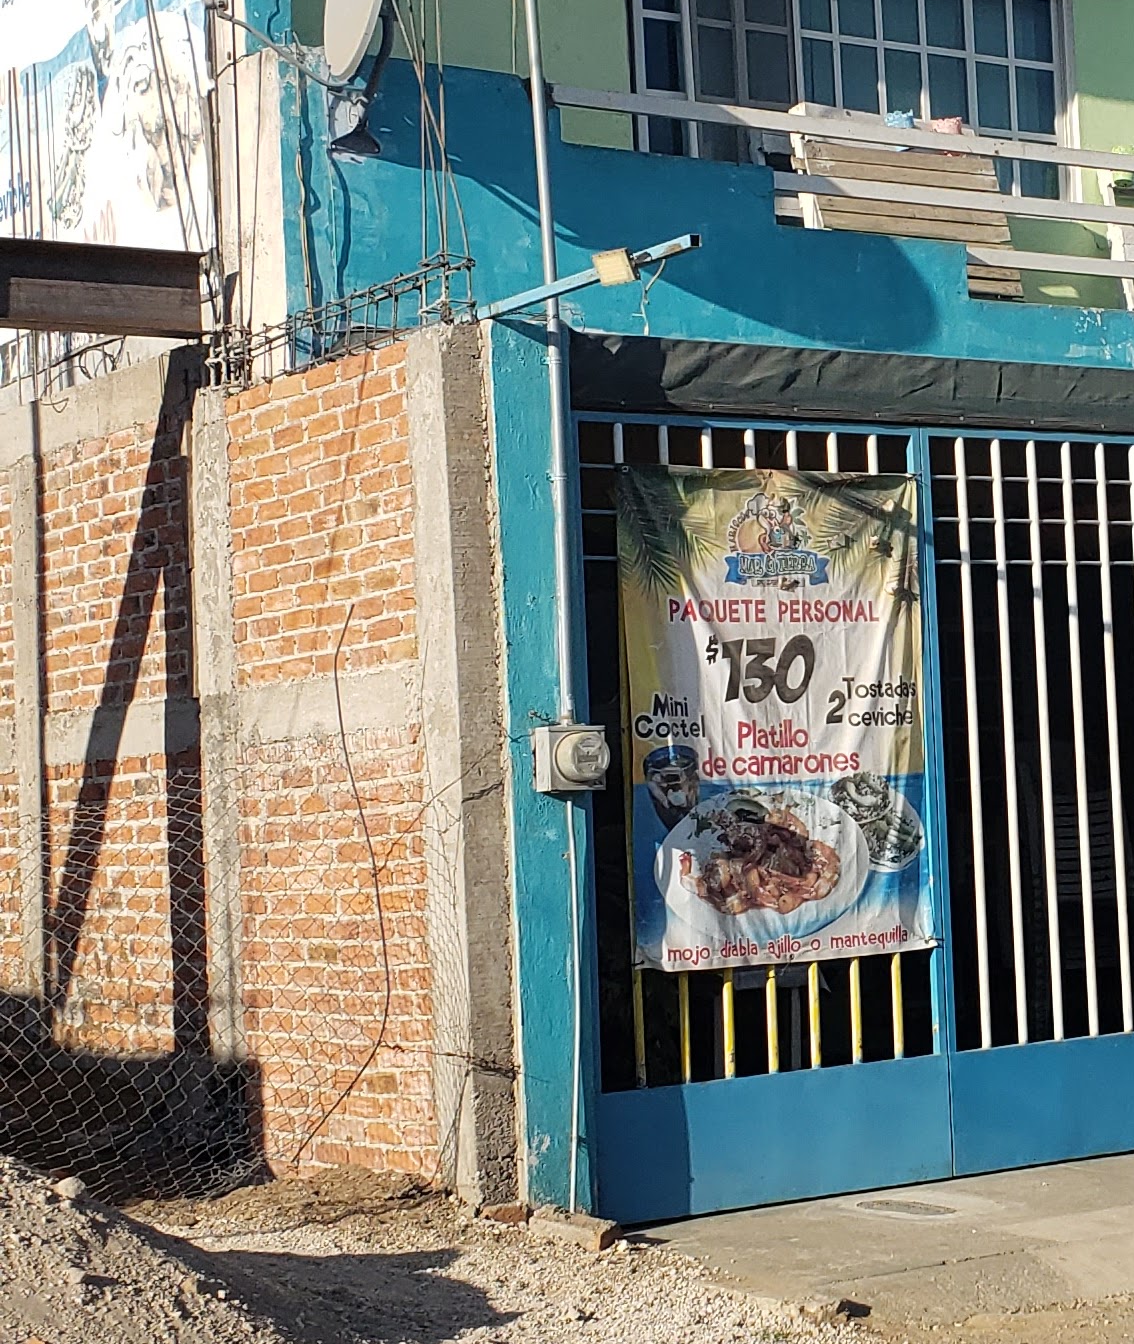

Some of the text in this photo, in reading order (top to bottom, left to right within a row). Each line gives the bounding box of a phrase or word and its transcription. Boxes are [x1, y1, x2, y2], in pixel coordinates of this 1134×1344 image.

[669, 598, 880, 623] PAQUETE PERSONAL
[705, 633, 815, 705] $130
[652, 693, 689, 719] Mini
[826, 675, 917, 725] 2 Tostadas
[634, 713, 706, 739] Coctel
[848, 704, 914, 728] ceviche
[738, 719, 809, 750] Platillo
[702, 747, 860, 778] de camarones
[667, 924, 909, 967] mojo diabla ajillo o mantequilla
